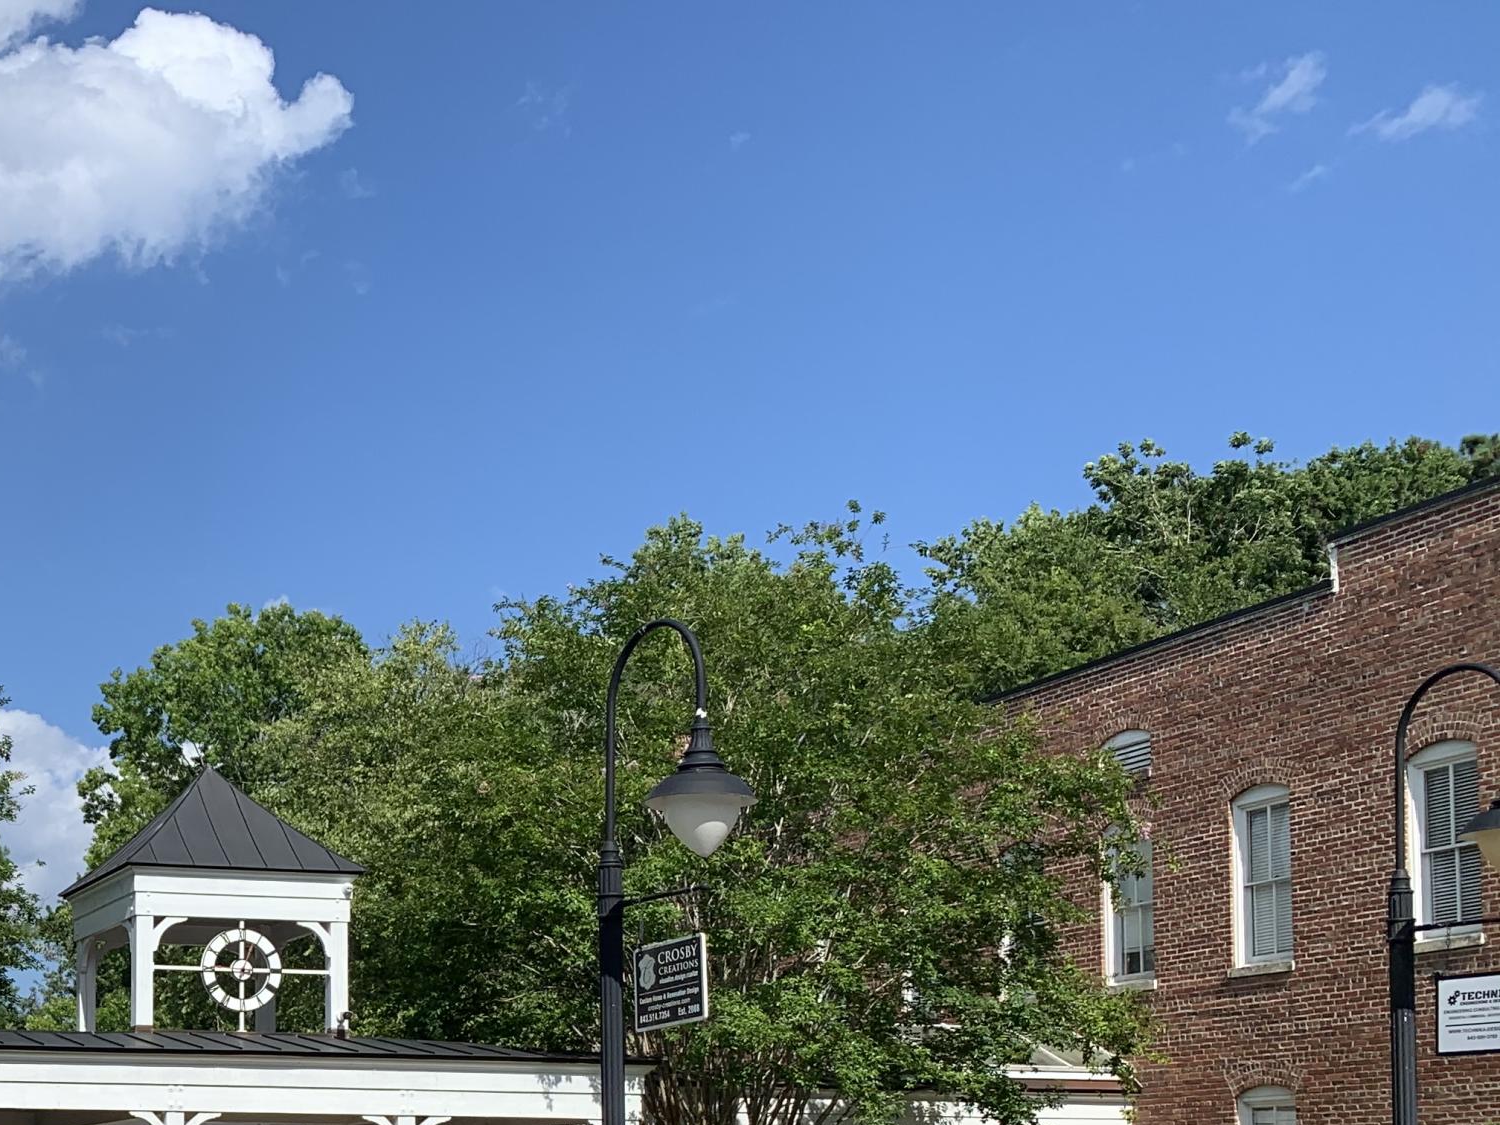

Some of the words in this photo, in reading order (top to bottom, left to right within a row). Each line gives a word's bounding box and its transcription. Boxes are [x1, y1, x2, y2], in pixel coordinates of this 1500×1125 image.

[658, 944, 698, 965] CROSBY
[658, 958, 699, 976] CREATIONS
[1461, 989, 1500, 1000] TECHN
